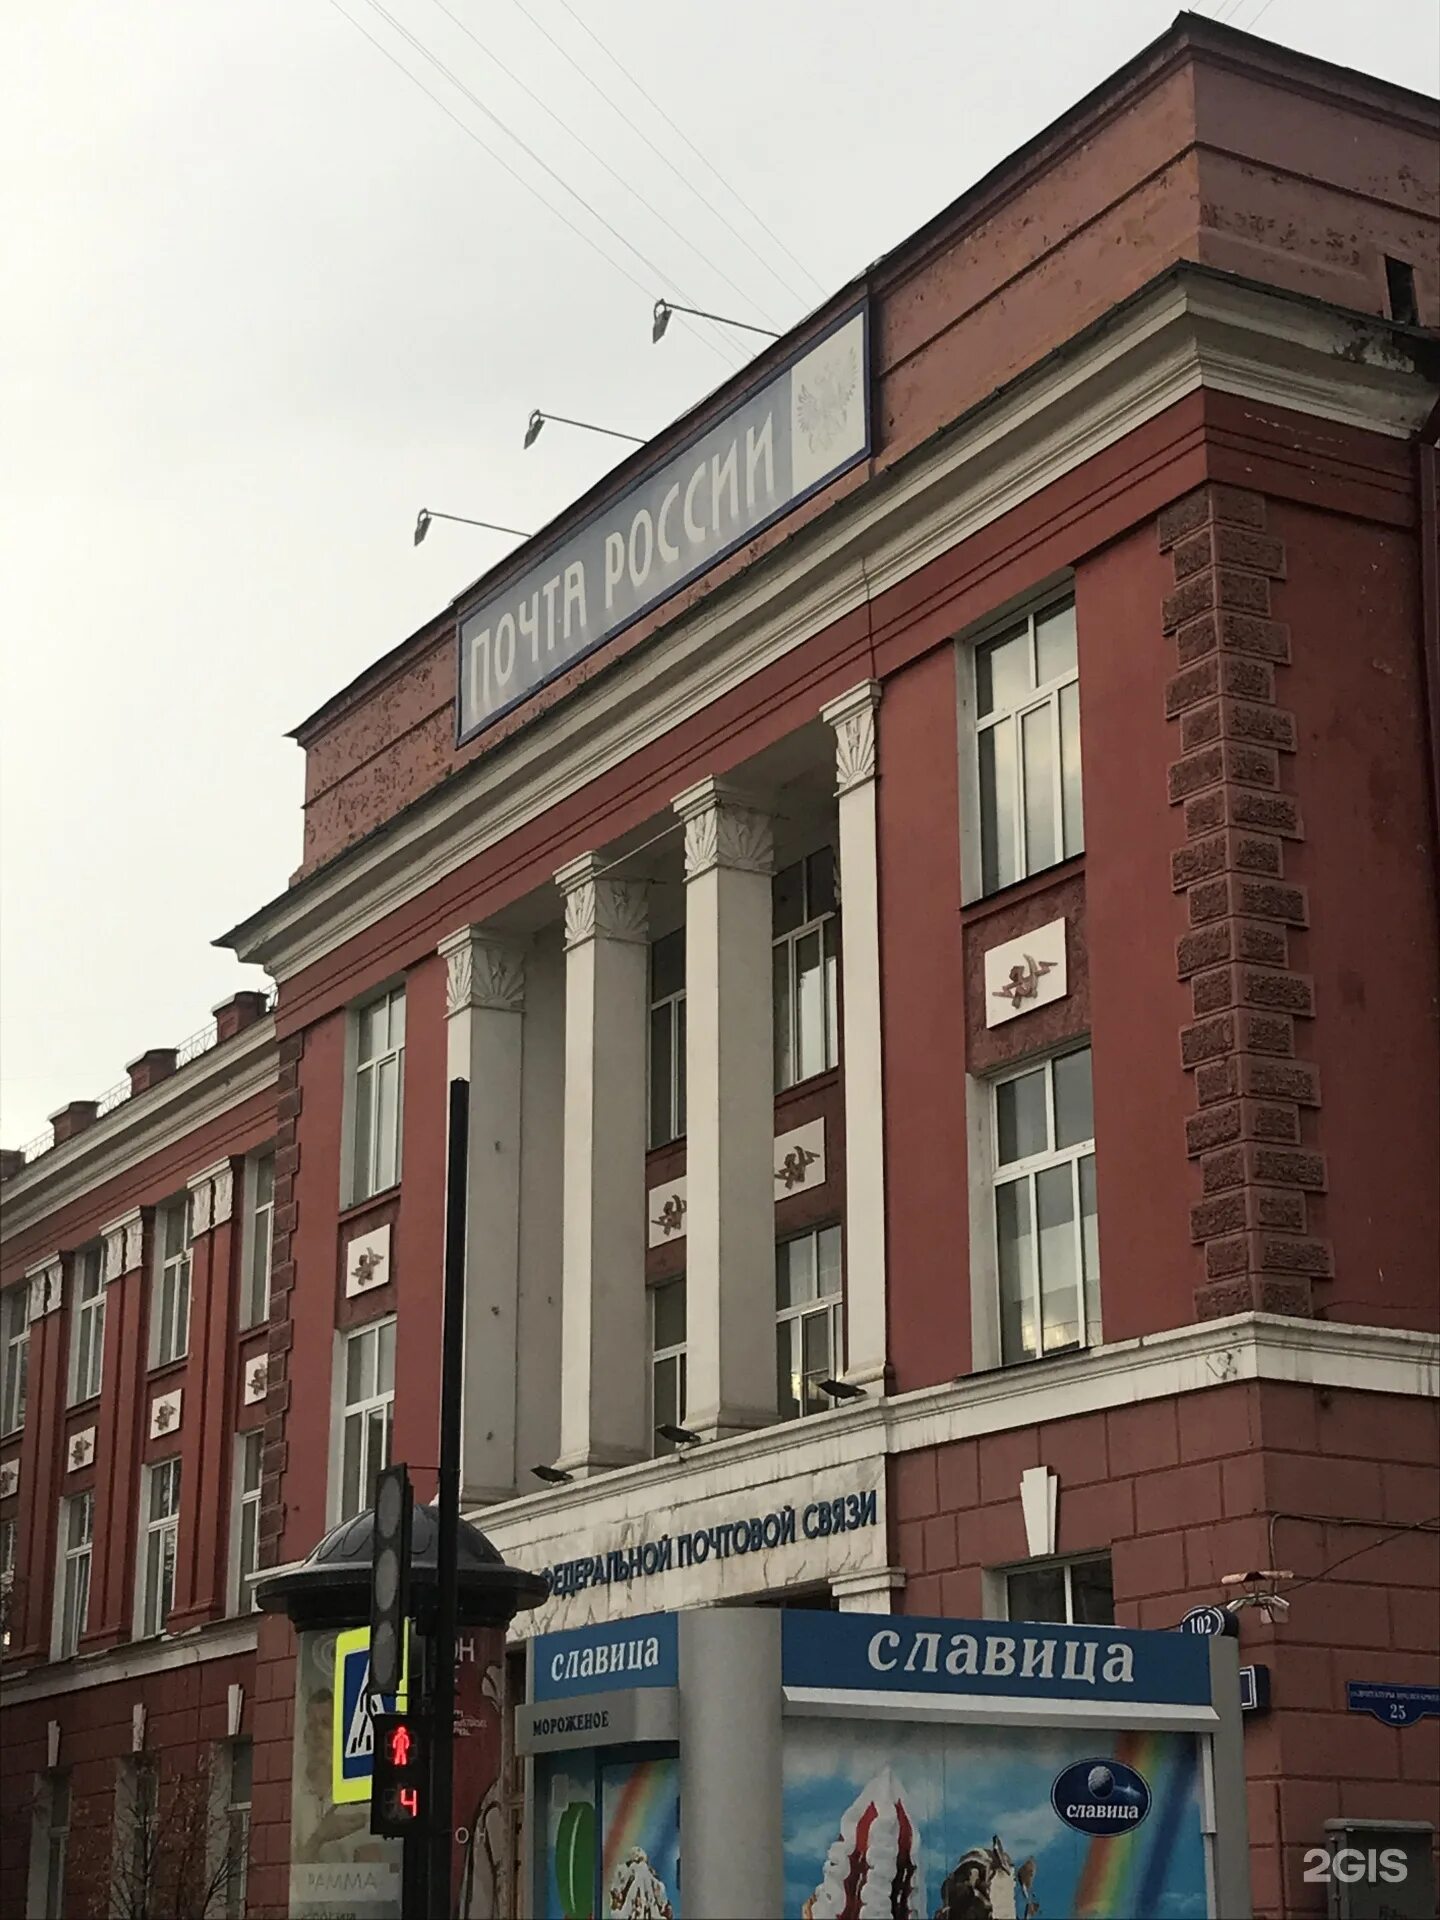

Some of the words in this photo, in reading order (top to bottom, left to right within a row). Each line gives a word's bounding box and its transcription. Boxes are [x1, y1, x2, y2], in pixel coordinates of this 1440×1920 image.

[470, 560, 586, 711] ПОЧТА
[605, 411, 774, 609] РОССИИ
[677, 1505, 795, 1567] ПОЧТОВОЙ
[802, 1489, 877, 1538] СВЯЗИ
[1190, 1615, 1212, 1634] 102
[551, 1637, 659, 1681] славица
[866, 1629, 1135, 1685] славица
[533, 1710, 609, 1736] МОРОЖЕНОЕ
[1389, 1703, 1407, 1720] 25
[400, 1789, 417, 1816] 4
[1066, 1801, 1139, 1821] славица
